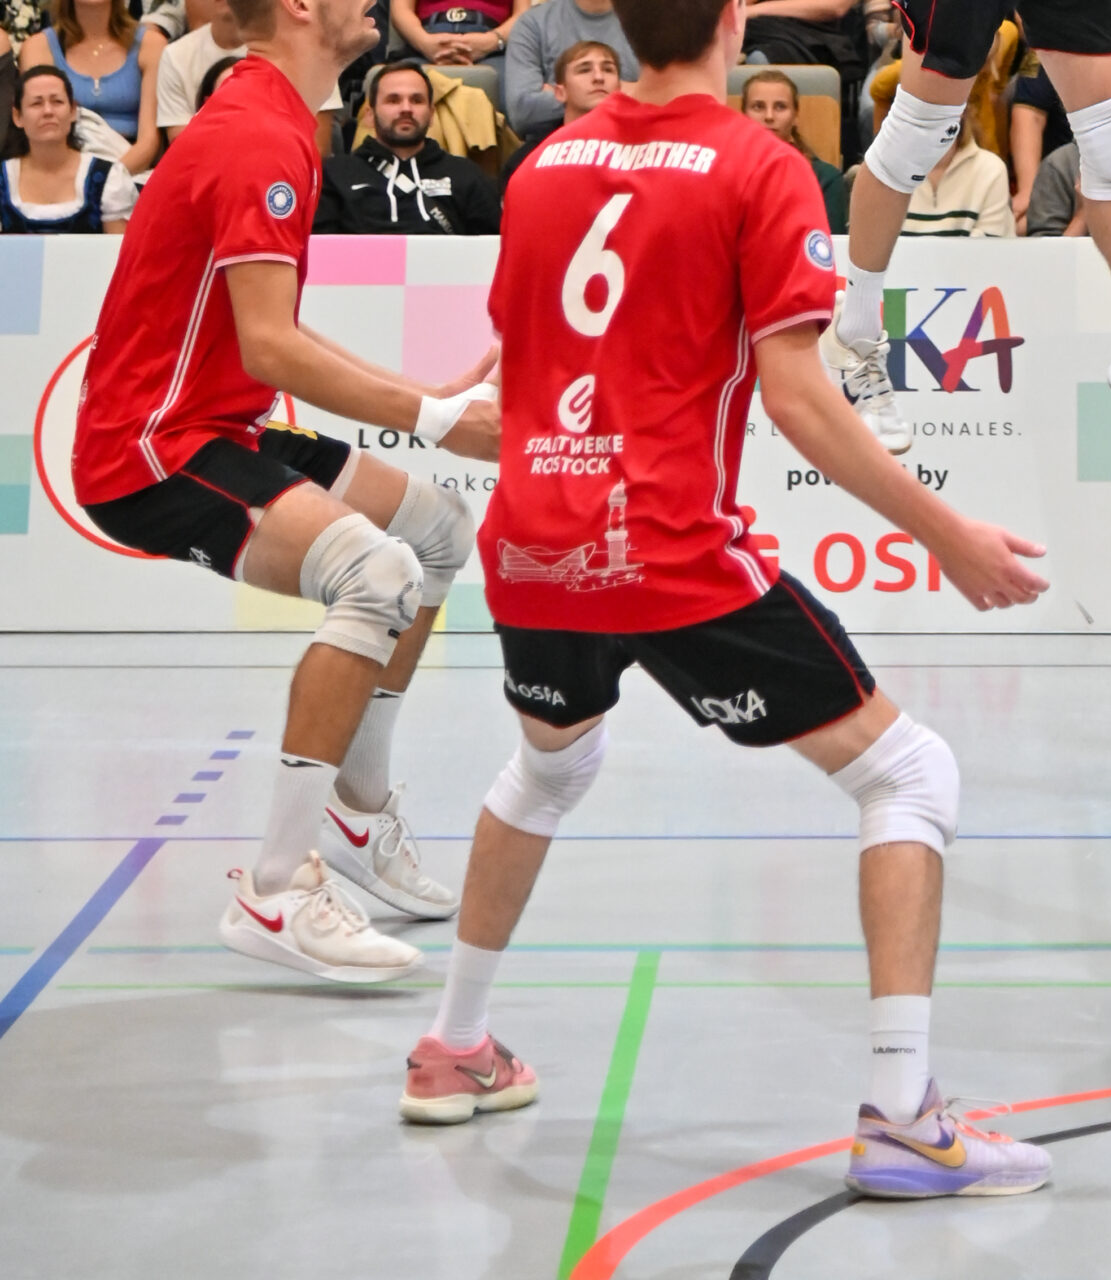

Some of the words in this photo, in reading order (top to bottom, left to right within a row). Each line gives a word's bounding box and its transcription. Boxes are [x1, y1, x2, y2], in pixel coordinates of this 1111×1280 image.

[534, 139, 717, 174] MERRYWEATHER
[561, 192, 634, 337] 6
[358, 428, 440, 449] LOK
[530, 455, 612, 475] ROSTOCK
[917, 464, 949, 490] by
[517, 683, 566, 706] OSPA
[691, 689, 767, 724] LOKA
